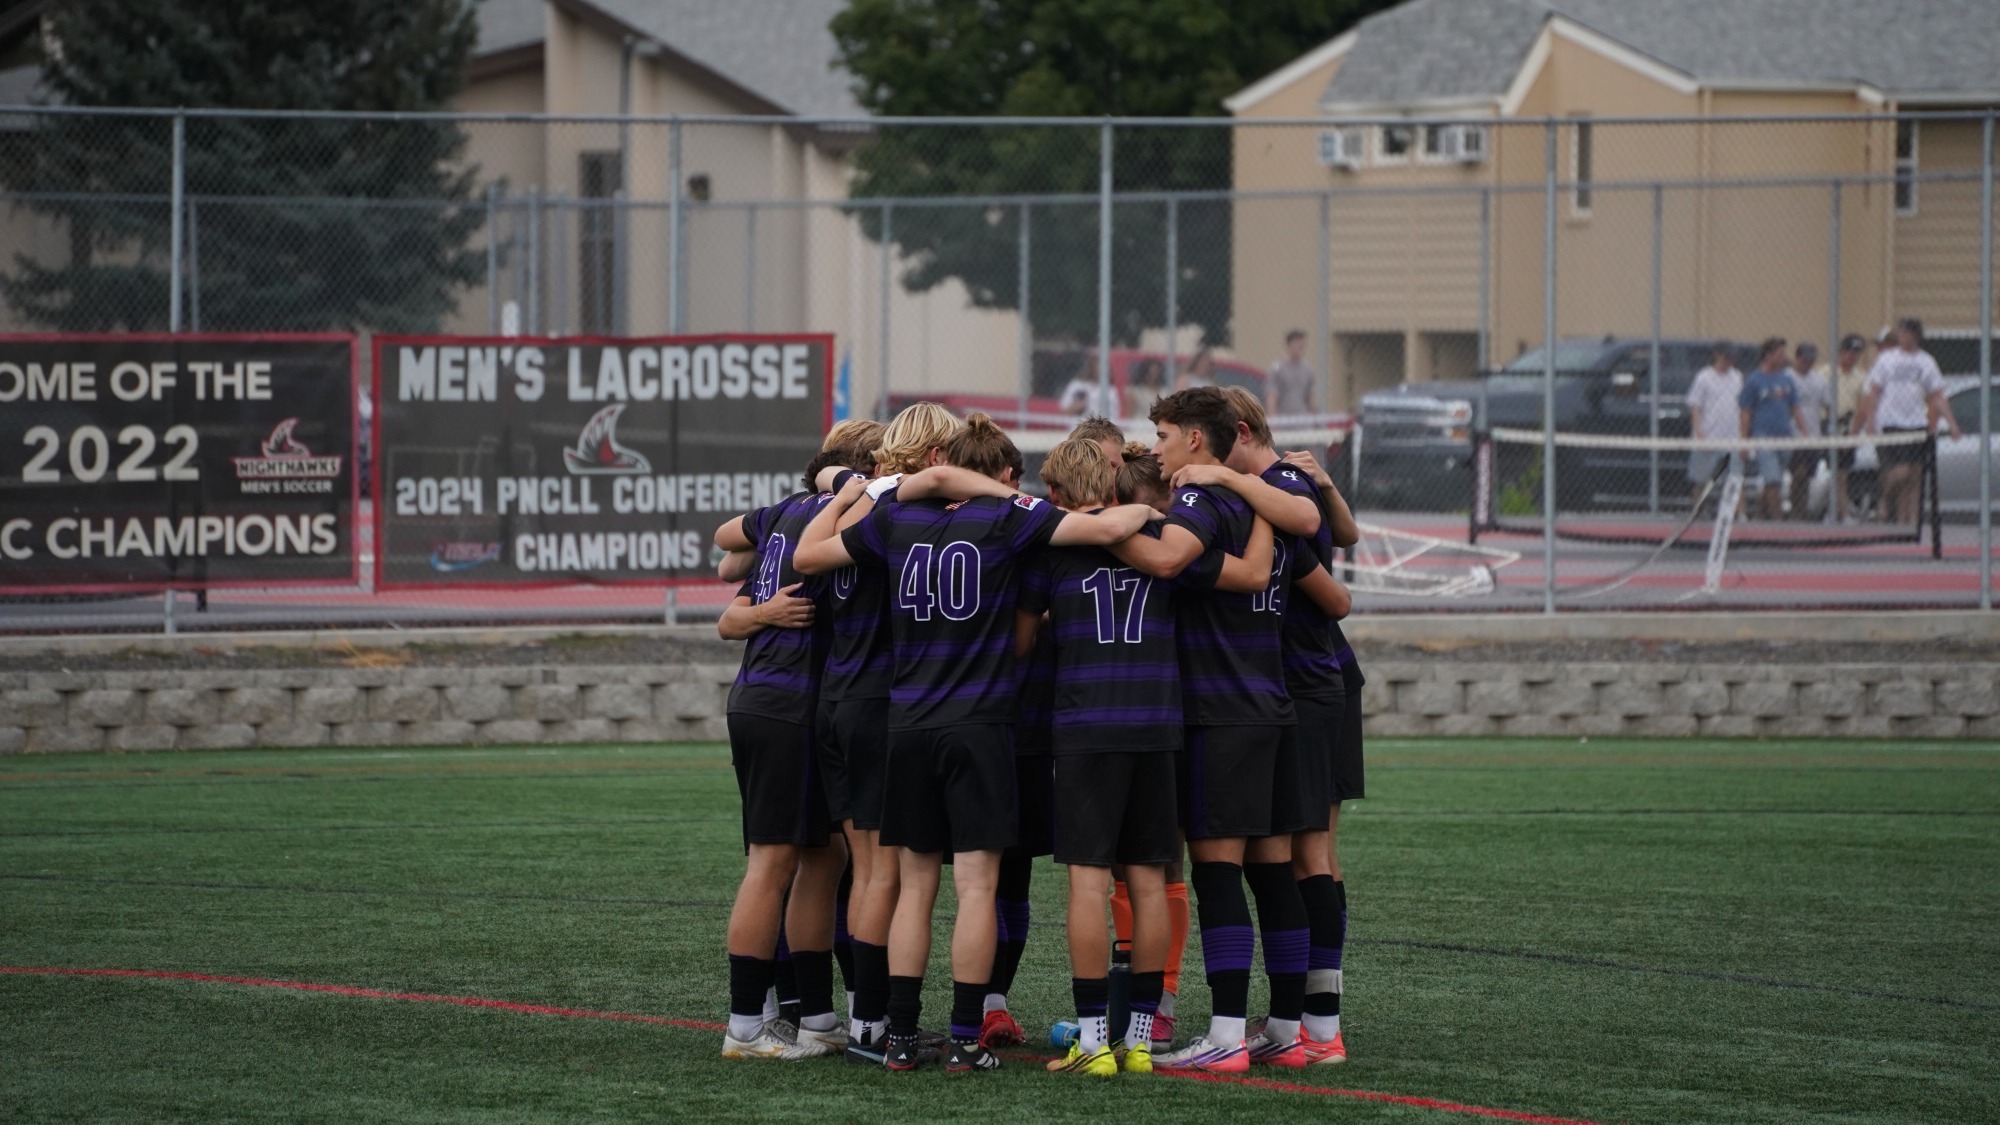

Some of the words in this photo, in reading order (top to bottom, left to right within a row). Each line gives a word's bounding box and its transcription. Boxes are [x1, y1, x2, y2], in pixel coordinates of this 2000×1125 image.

[110, 361, 177, 400] OF
[187, 362, 272, 400] THE
[399, 346, 545, 401] MEN'S
[567, 344, 808, 400] LACROSSE
[22, 425, 199, 482] 2022
[240, 460, 337, 474] NIGHTHAWKS
[241, 480, 280, 493] MEN'S
[283, 480, 332, 493] SOCCER
[396, 477, 482, 515] 2024
[497, 477, 599, 515] PNCLL
[46, 514, 337, 559] CHAMPIONS
[516, 532, 701, 571] CHAMPIONS
[899, 541, 981, 621] 40
[1082, 567, 1153, 643] 17
